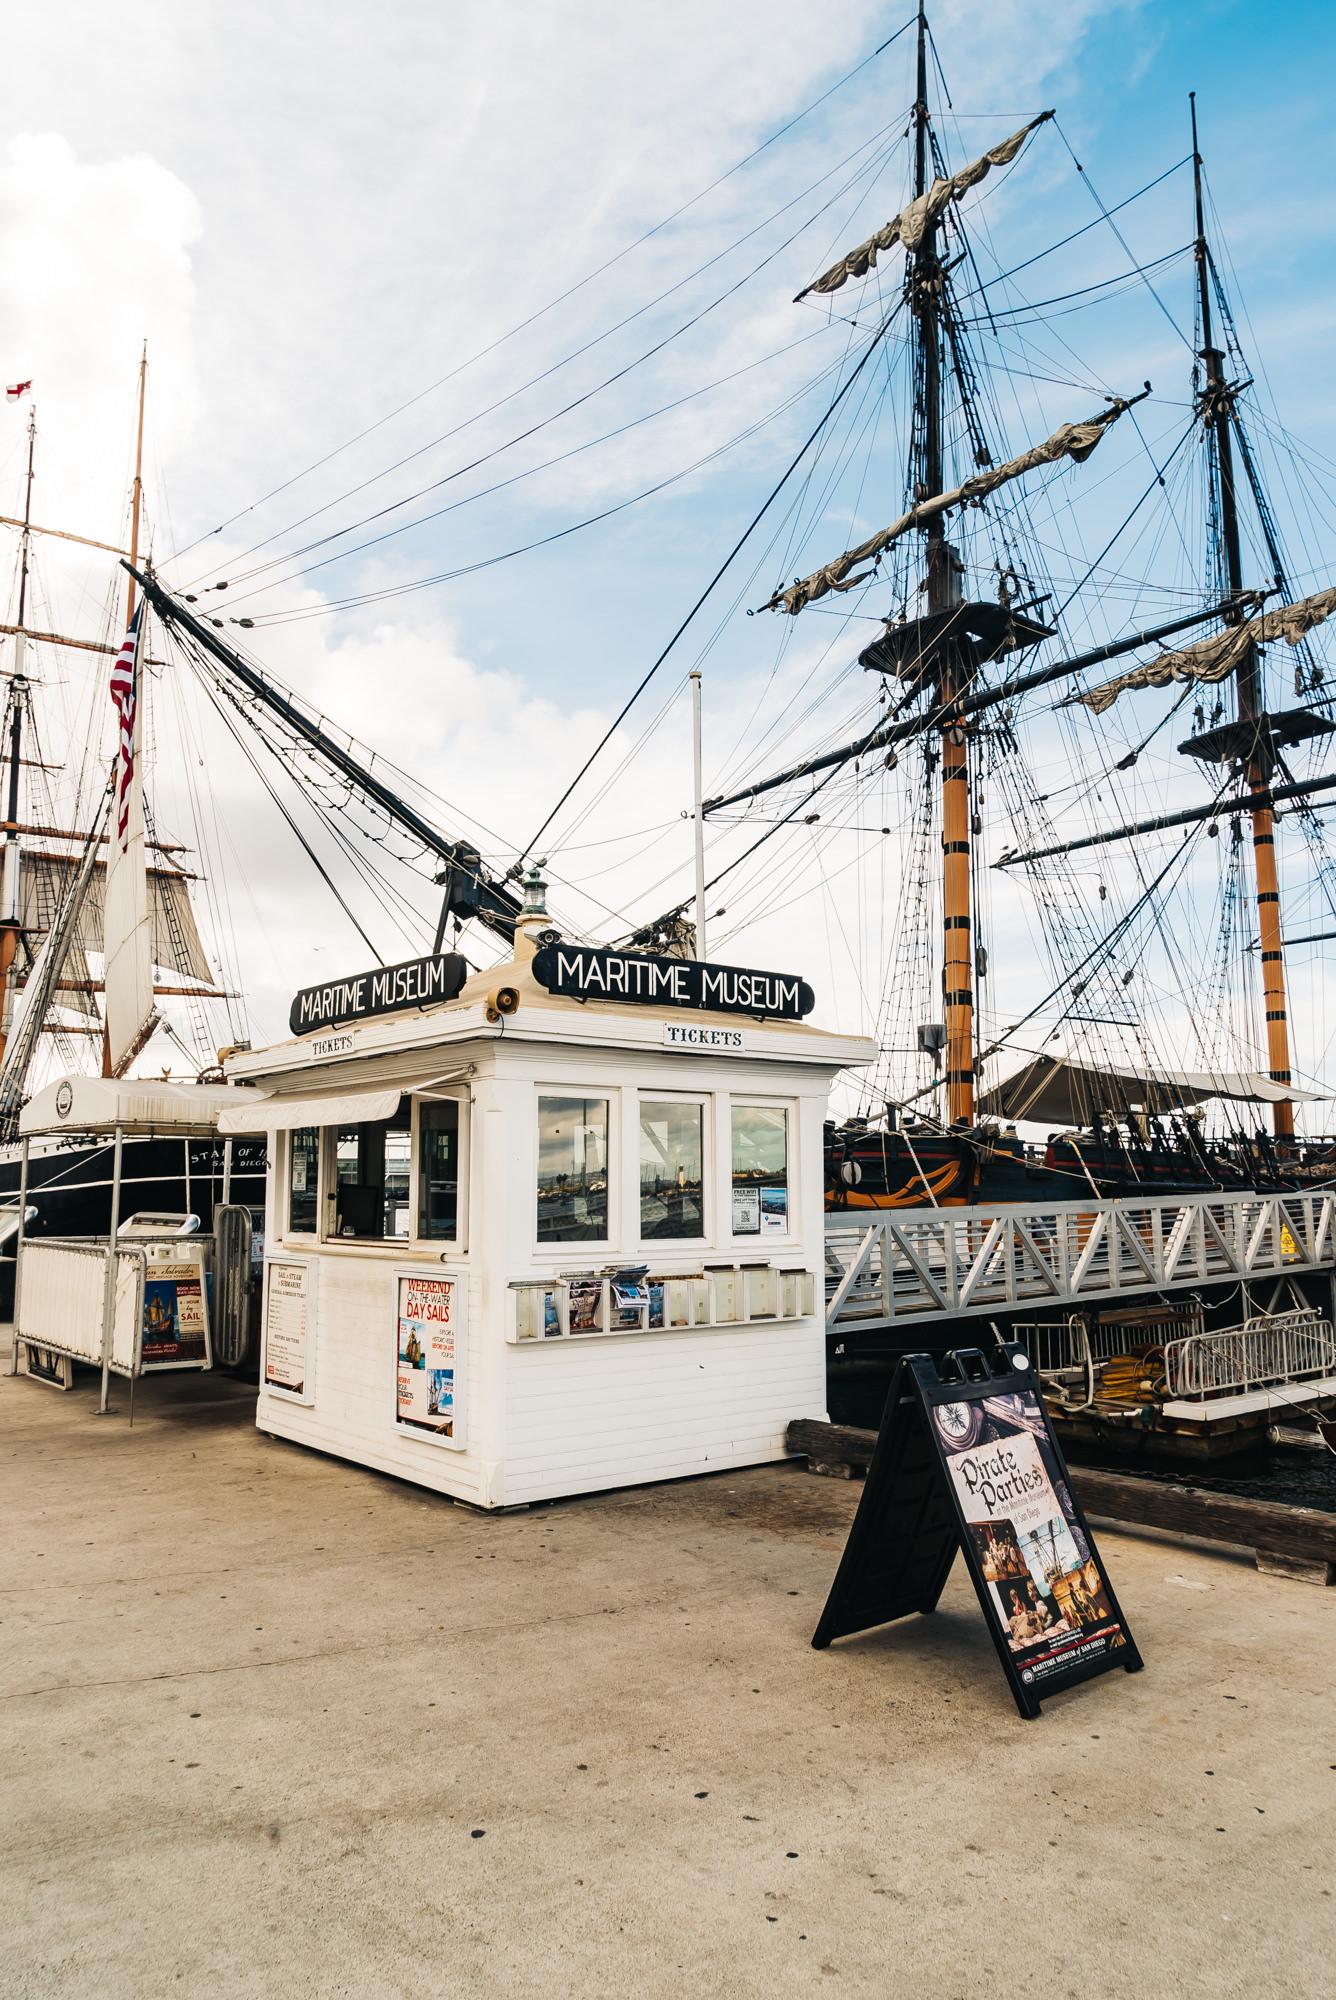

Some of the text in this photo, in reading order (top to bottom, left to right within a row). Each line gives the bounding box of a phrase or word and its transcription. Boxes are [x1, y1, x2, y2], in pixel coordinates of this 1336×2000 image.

[300, 958, 445, 1024] MARITIME MUSEUM
[558, 951, 799, 1013] MARITIME MUSEUM
[312, 1035, 353, 1056] TICKETS
[667, 1026, 742, 1047] TICKETS
[191, 1149, 226, 1164] STA
[238, 1148, 253, 1157] OF
[160, 1264, 195, 1275] Salvador
[278, 1271, 286, 1279] SAIL
[280, 1280, 301, 1289] SUBMARINE
[408, 1279, 451, 1295] WEEKEND
[181, 1312, 200, 1321] SAIL
[407, 1302, 450, 1323] DAY SAILS
[956, 1448, 1017, 1495] Pirate
[976, 1464, 1043, 1516] Parties
[1002, 1503, 1010, 1512] the
[1009, 1496, 1029, 1509] Maritime
[1028, 1490, 1047, 1502] Museum
[1014, 1506, 1041, 1525] of San Diego
[1031, 1657, 1057, 1673] MARITIME
[1055, 1649, 1077, 1664] MUSEUM
[1076, 1646, 1081, 1656] of
[1080, 1643, 1091, 1653] SAN
[1090, 1637, 1106, 1649] DIEGO
